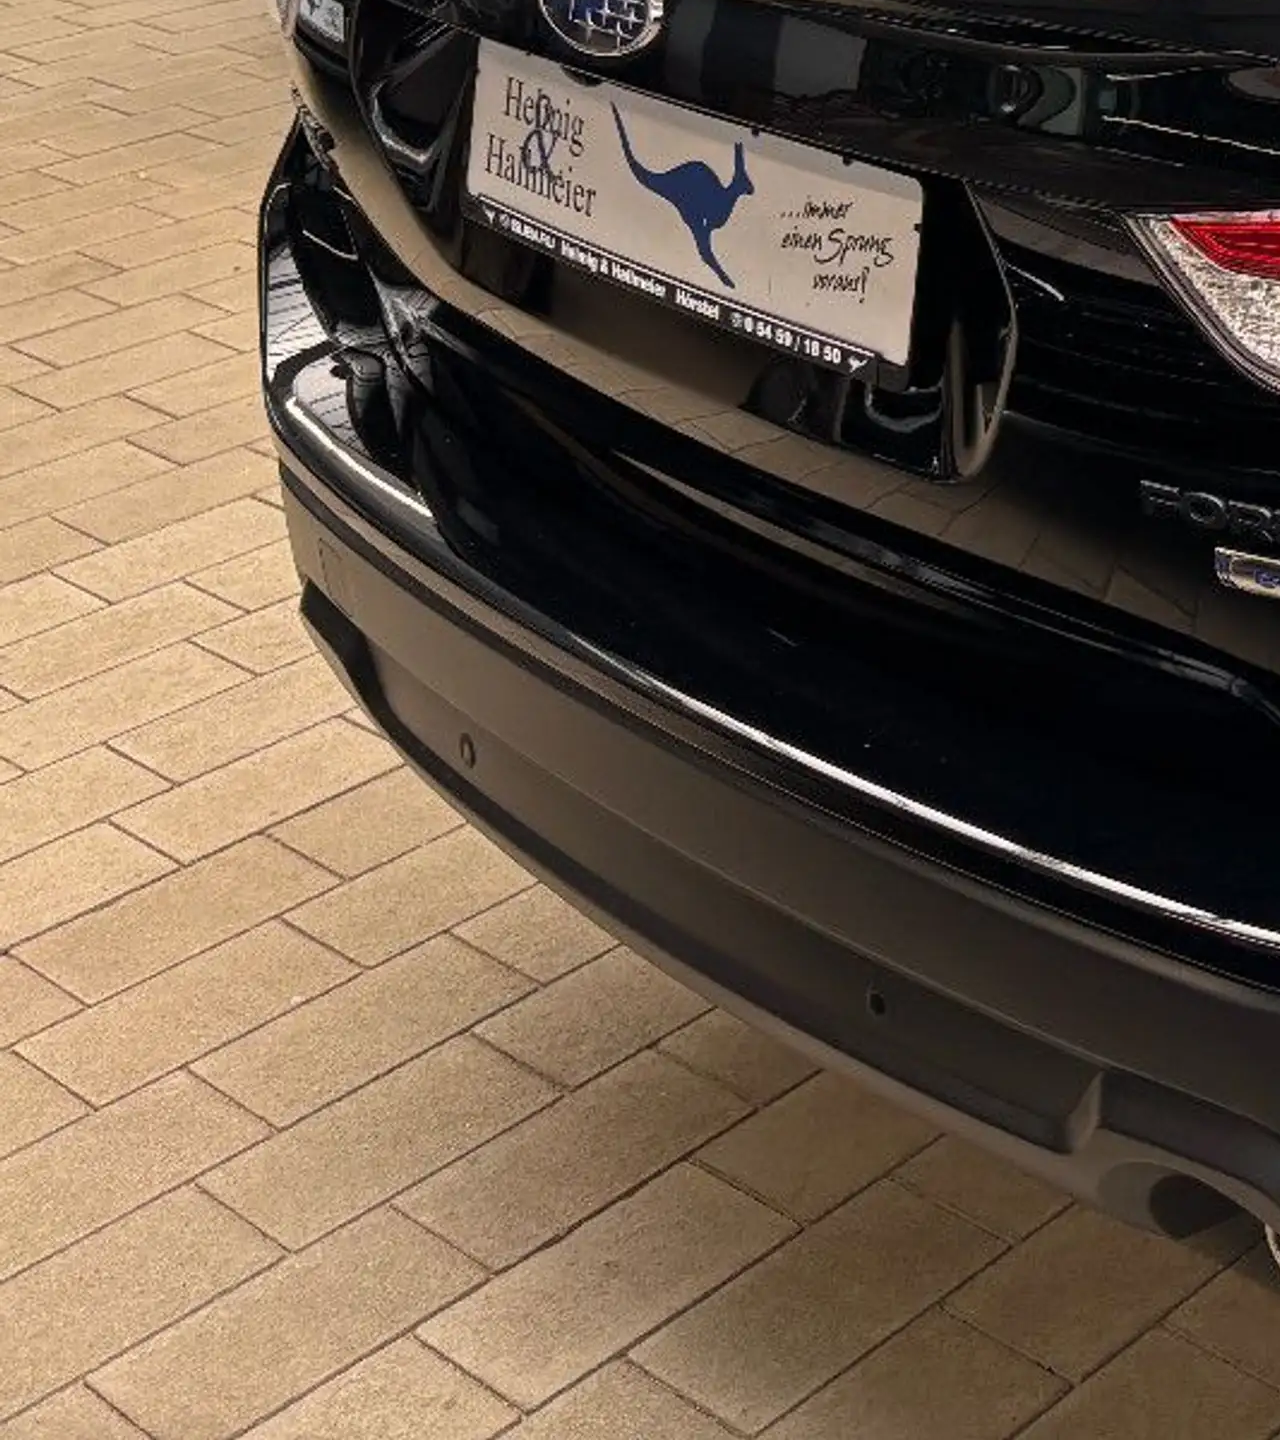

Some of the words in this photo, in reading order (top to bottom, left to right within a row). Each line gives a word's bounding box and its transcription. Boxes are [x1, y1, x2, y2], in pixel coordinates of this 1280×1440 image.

[781, 225, 822, 250] einen
[814, 227, 894, 268] Sprung
[813, 266, 870, 303] voraus!
[756, 321, 773, 340] 54
[823, 347, 842, 364] 50
